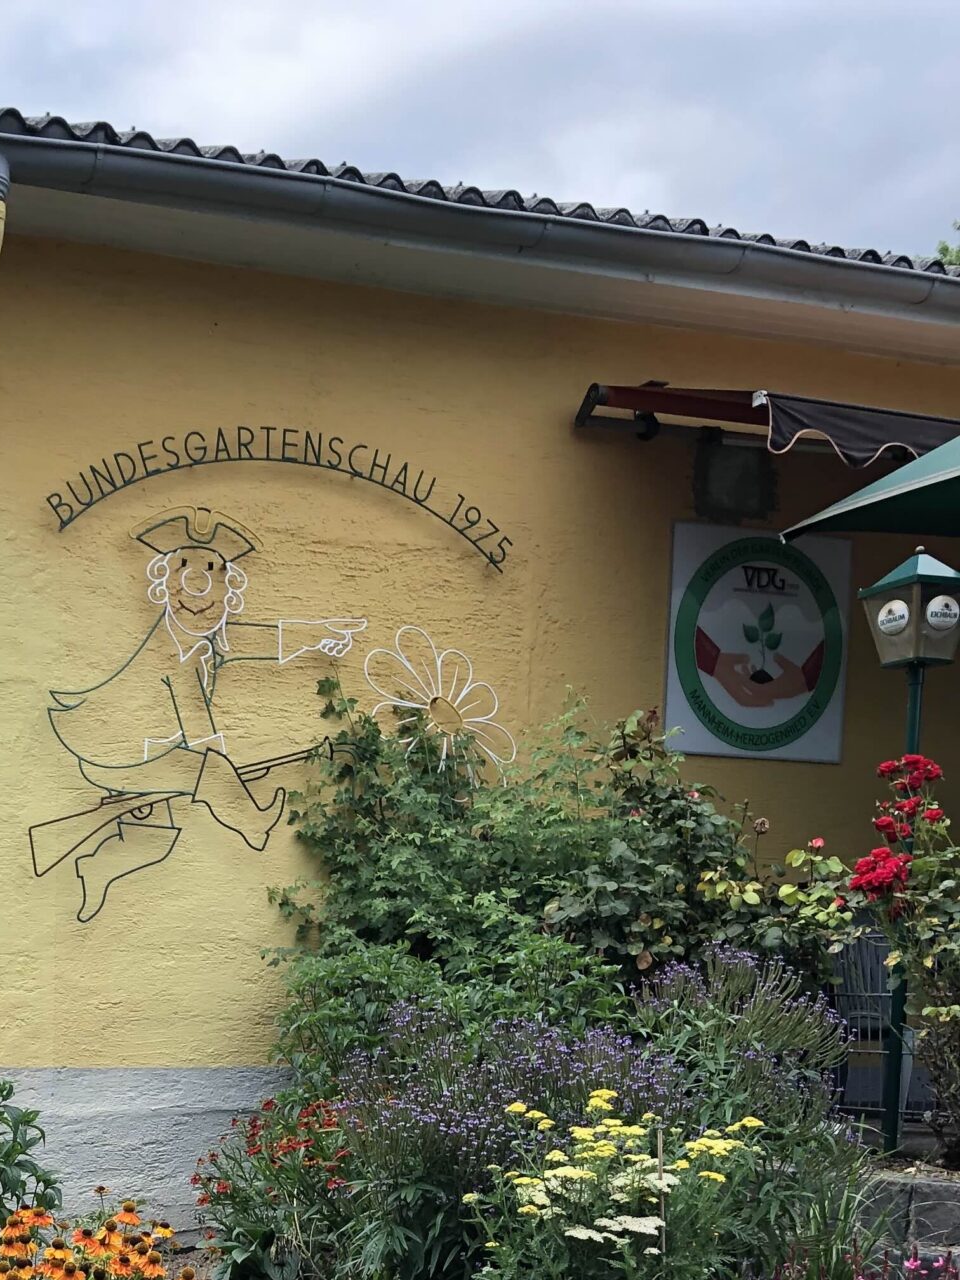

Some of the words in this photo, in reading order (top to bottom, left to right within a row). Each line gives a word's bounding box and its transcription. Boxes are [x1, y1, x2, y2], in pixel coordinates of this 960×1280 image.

[46, 426, 436, 526] BUNDESGARTENSCHAU
[449, 494, 514, 564] 1975
[741, 565, 786, 592] VDG
